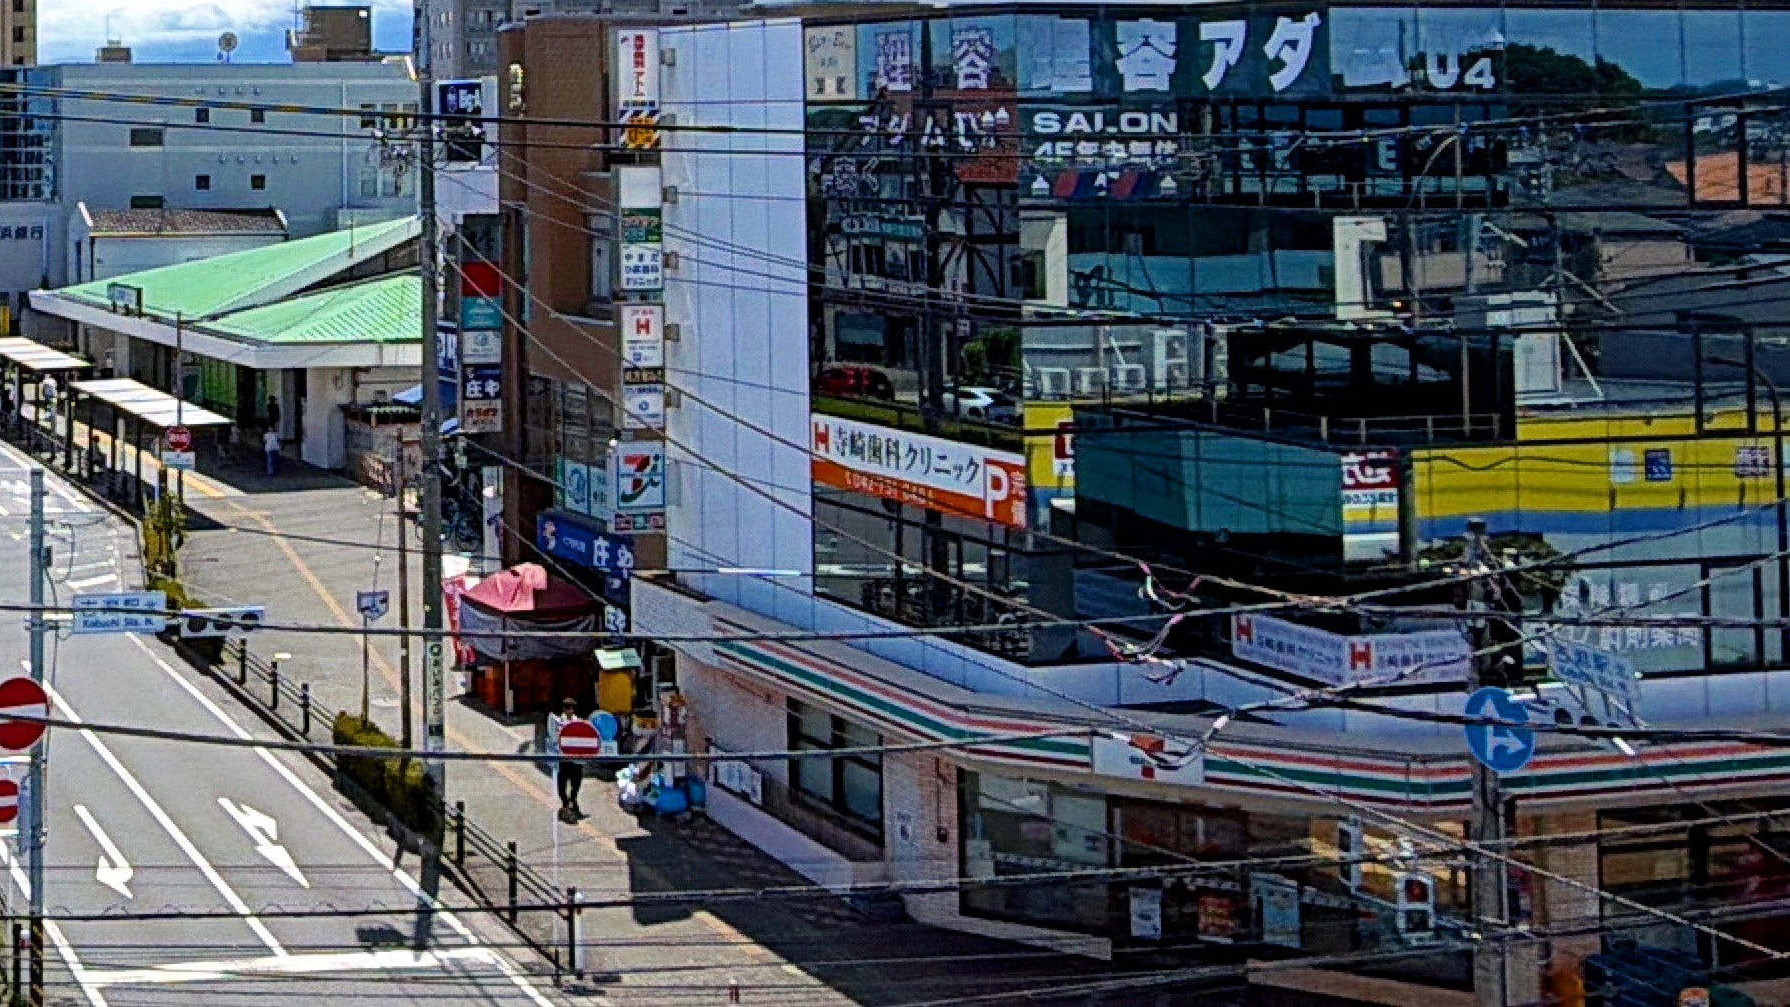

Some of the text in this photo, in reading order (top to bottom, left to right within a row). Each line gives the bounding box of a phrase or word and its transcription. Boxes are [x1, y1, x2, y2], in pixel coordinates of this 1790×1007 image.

[1033, 111, 1177, 133] SALON
[636, 318, 651, 335] H
[833, 426, 980, 484] 寺崎歯科クリニック
[986, 463, 1011, 518] P
